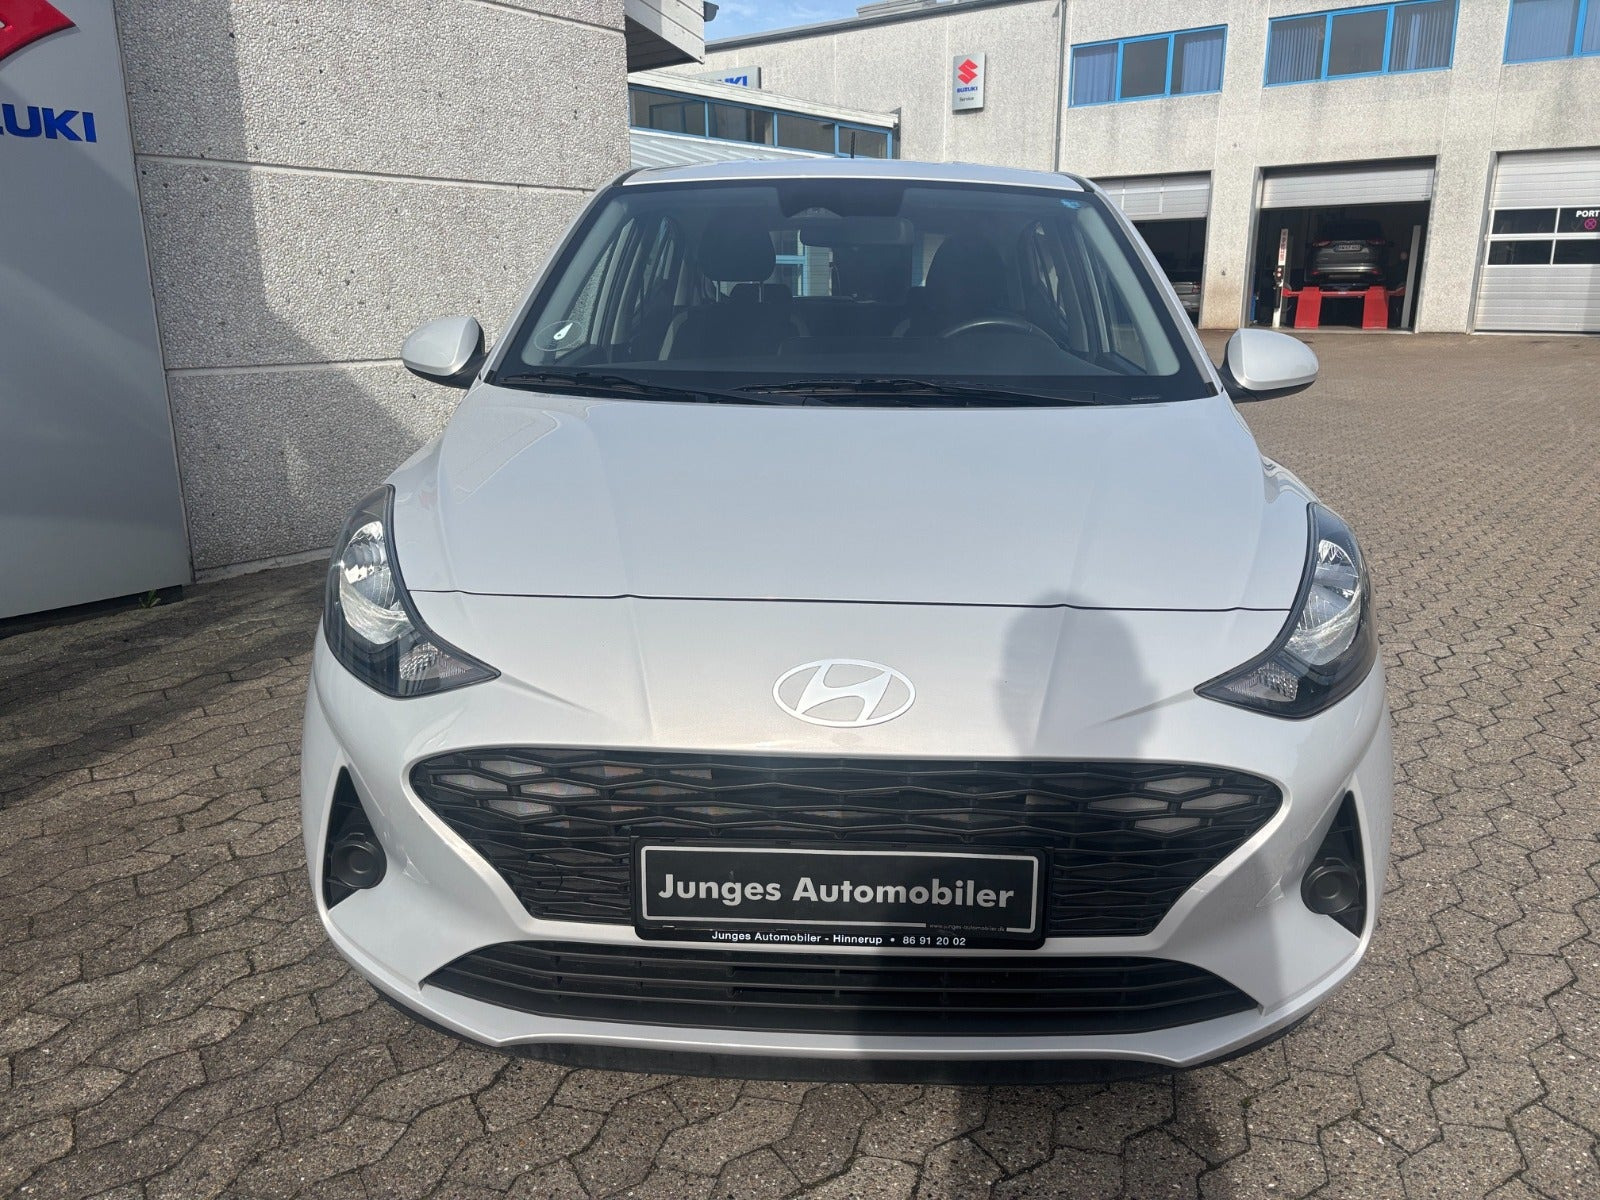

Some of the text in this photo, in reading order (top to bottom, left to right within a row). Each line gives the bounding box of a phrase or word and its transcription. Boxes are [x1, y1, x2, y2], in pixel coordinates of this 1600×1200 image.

[1575, 210, 1600, 218] PORT
[658, 873, 1014, 908] Junges Automobiler
[711, 931, 751, 941] Junges
[754, 932, 822, 943] Automobiler
[833, 935, 883, 945] Hinnerup
[902, 936, 916, 945] 86
[919, 936, 932, 945] 91
[936, 936, 950, 946] 20
[952, 937, 967, 946] 02
